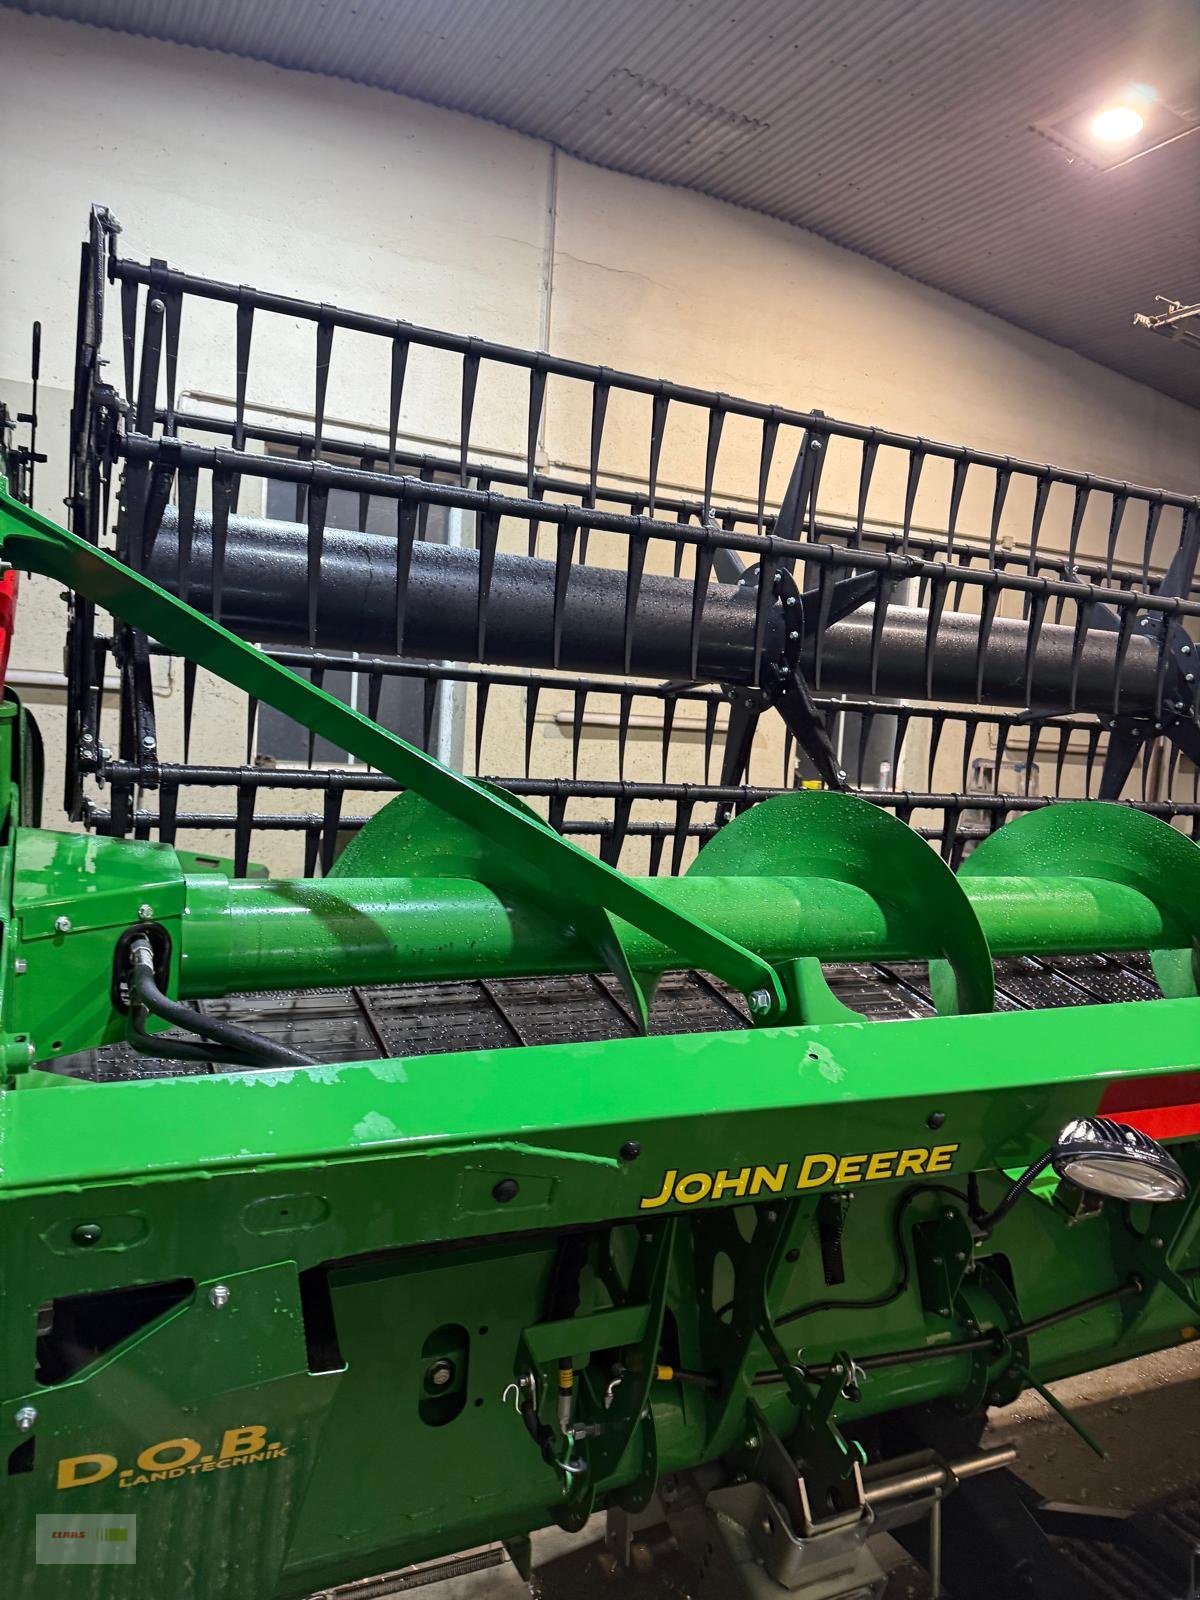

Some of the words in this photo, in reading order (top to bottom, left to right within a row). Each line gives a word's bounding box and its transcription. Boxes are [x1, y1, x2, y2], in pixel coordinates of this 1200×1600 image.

[640, 1163, 789, 1209] JOHN
[796, 1144, 959, 1189] DEERE
[56, 1425, 281, 1489] D.O.B.
[118, 1447, 288, 1489] LANDTECHNIK
